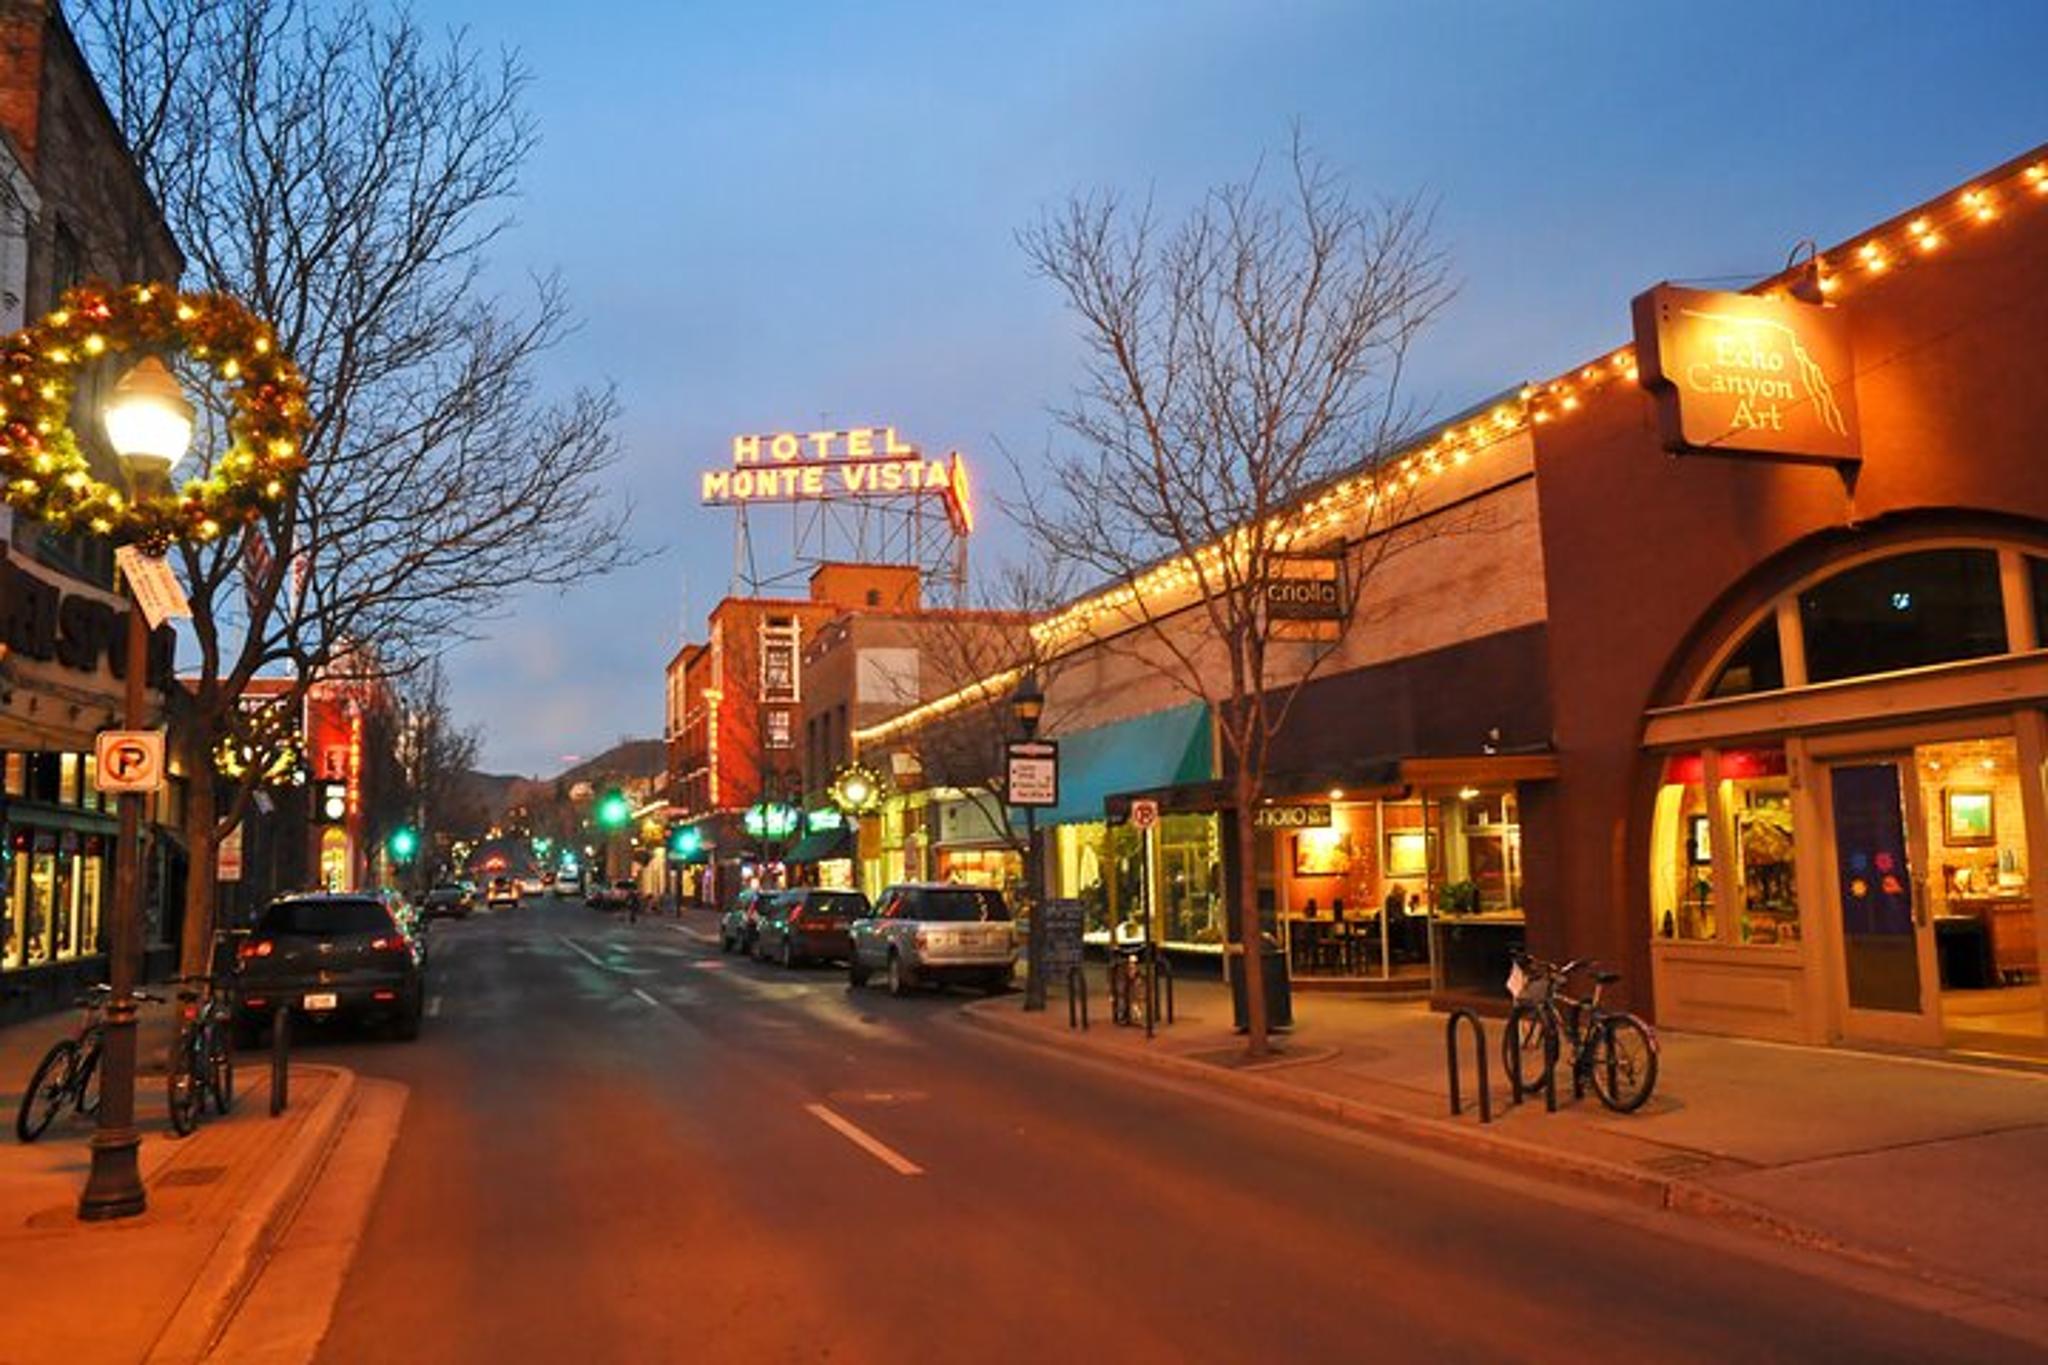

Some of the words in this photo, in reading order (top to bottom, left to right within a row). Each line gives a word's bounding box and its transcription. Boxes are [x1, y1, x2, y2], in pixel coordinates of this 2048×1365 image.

[1716, 336, 1784, 371] Echo
[1687, 363, 1795, 408] Canyon
[1730, 399, 1783, 432] Art
[733, 428, 911, 463] HOTEL
[703, 465, 823, 500] MONTE
[840, 459, 950, 492] VISTA
